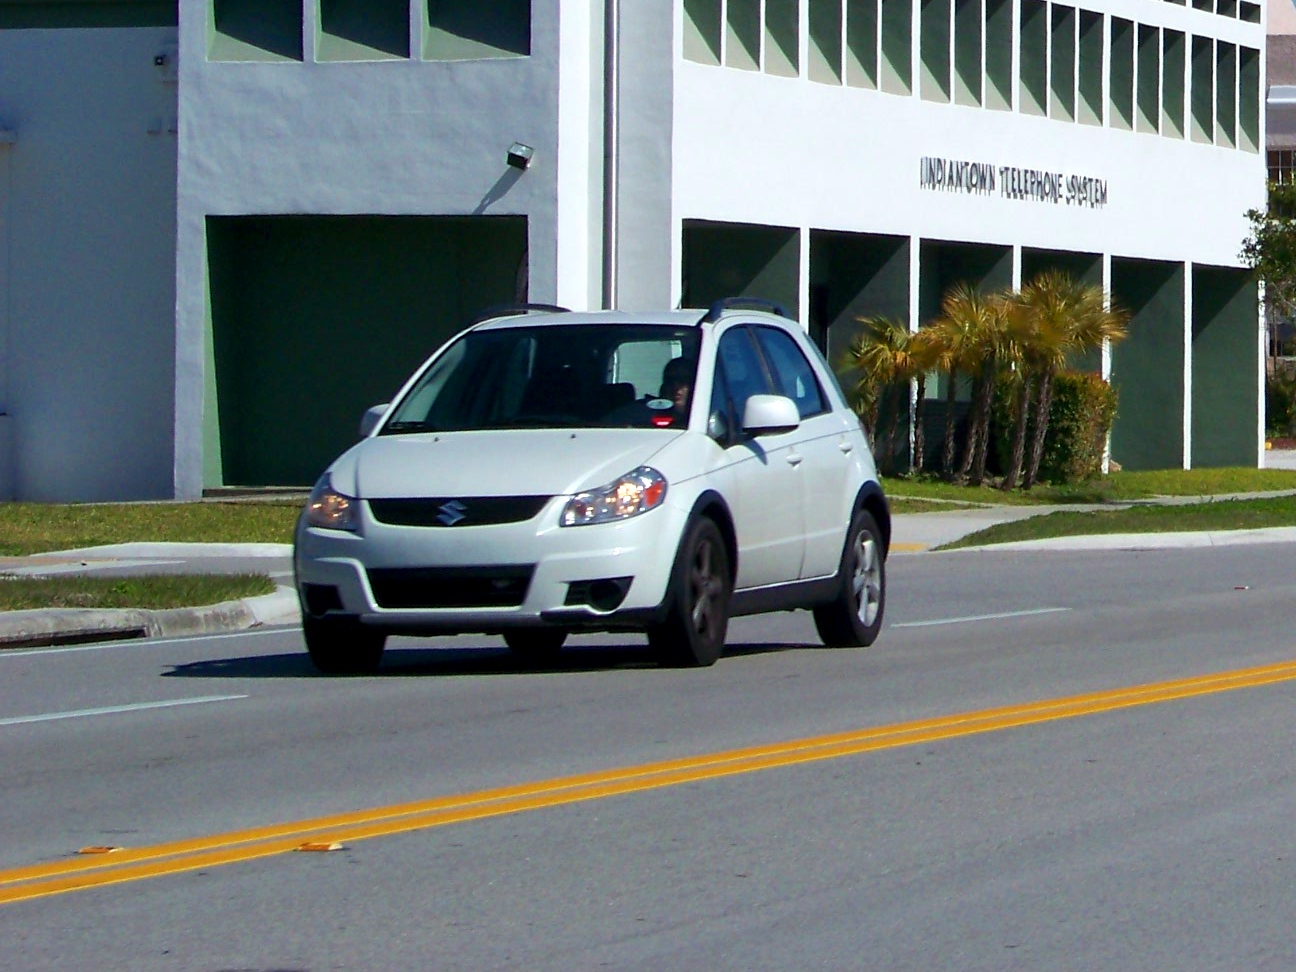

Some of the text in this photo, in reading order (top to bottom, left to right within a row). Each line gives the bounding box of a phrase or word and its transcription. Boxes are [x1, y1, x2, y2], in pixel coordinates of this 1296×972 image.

[921, 156, 1107, 207] INDIANTOWN TELEPHONE SYSTEM
